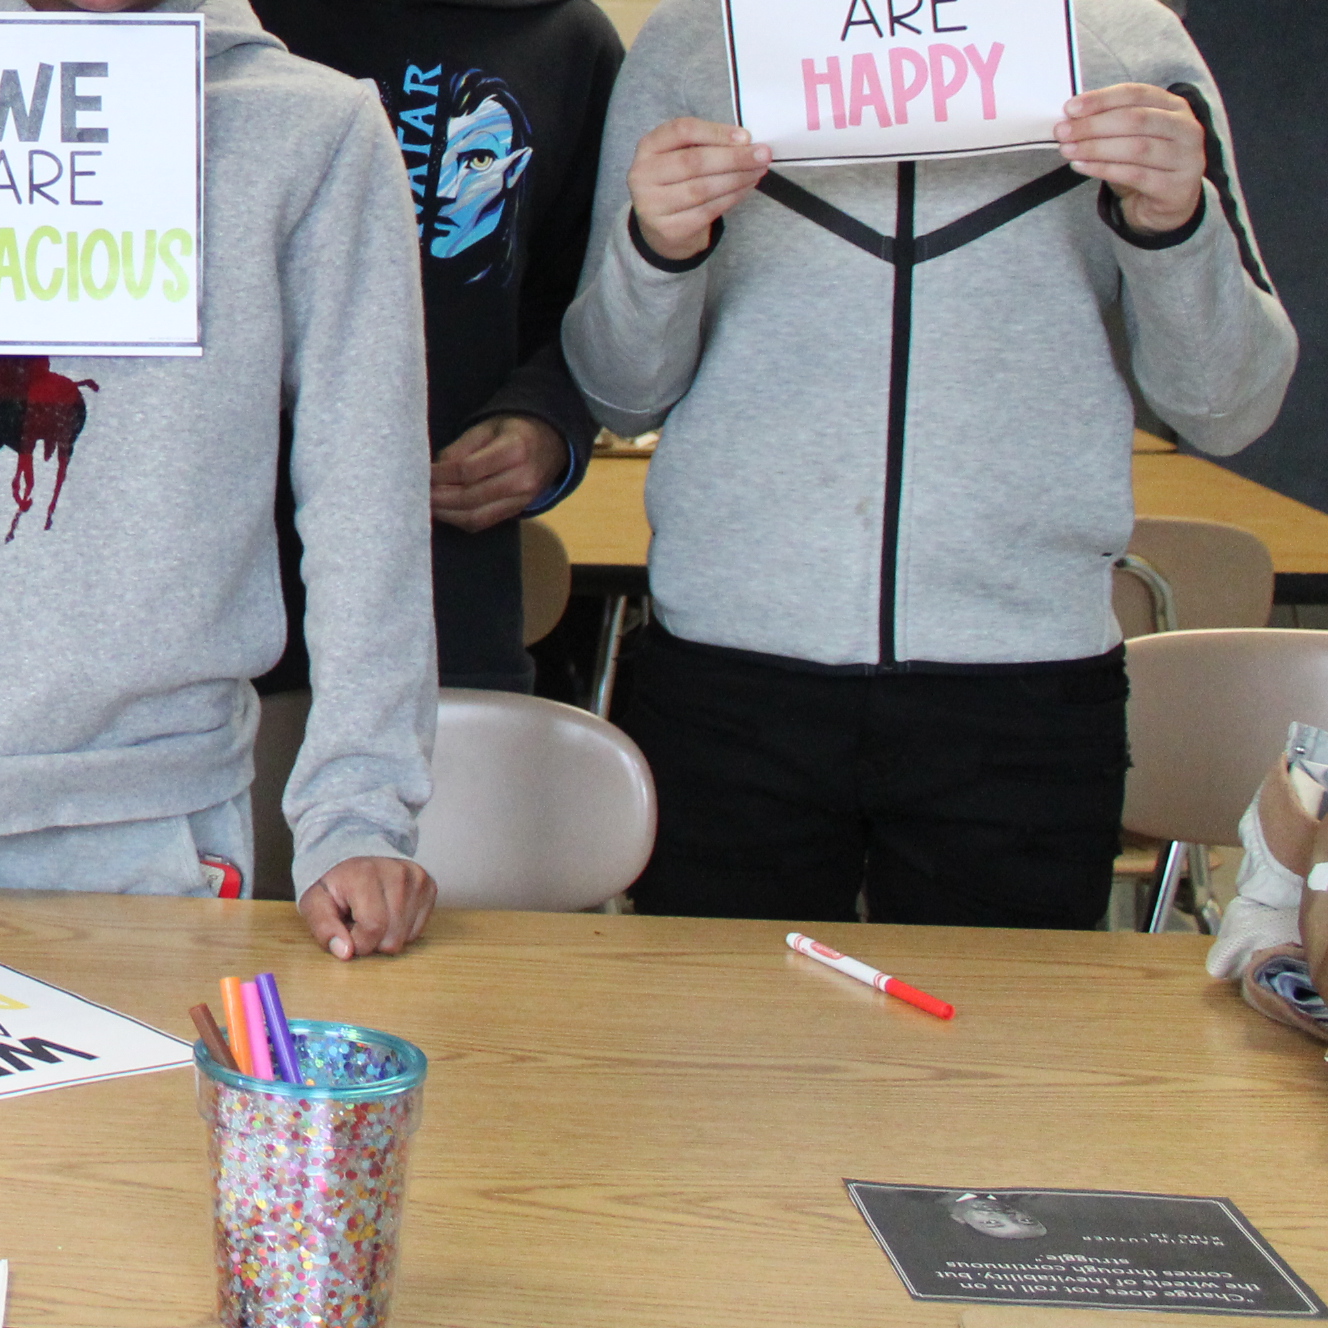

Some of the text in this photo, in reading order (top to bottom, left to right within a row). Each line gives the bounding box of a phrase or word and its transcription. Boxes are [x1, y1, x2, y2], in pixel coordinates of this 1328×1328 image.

[801, 42, 1005, 131] HAPPY
[397, 63, 443, 237] ATAR
[1082, 1235, 1225, 1246] MARTIN LUTHER
[935, 1270, 972, 1280] but
[945, 1261, 1233, 1278] comes through continuous
[1115, 1277, 1138, 1287] of
[1143, 1279, 1220, 1289] wheels
[1226, 1282, 1261, 1291] the
[960, 1282, 1254, 1303] "Change does not roll in on
